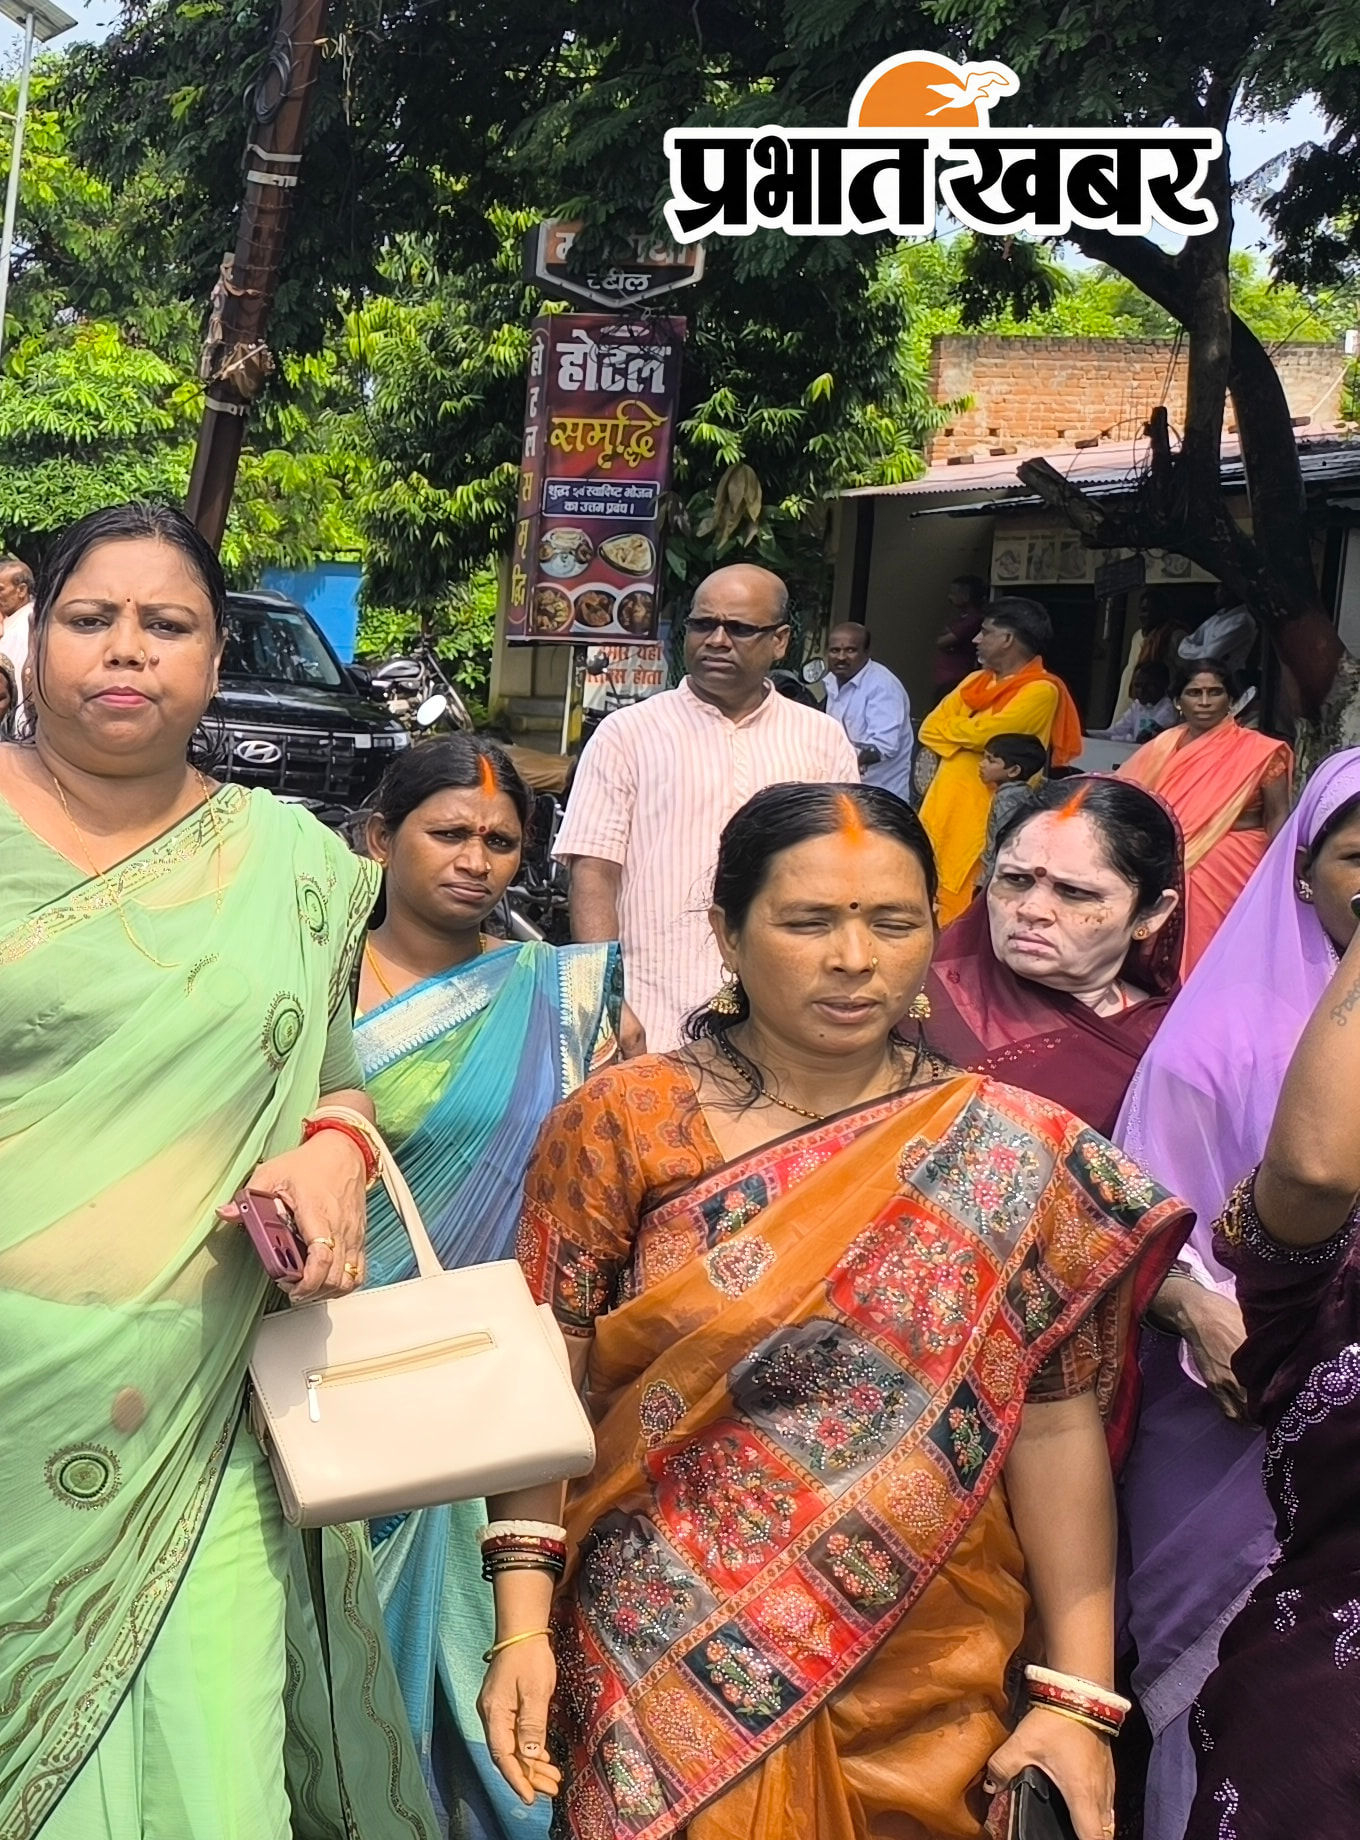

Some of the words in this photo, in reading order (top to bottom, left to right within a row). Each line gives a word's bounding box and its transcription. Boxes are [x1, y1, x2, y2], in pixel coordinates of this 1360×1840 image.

[556, 329, 672, 393] होटल
[550, 399, 669, 470] समृद्धि
[564, 501, 578, 513] का
[624, 484, 654, 499] भोजन
